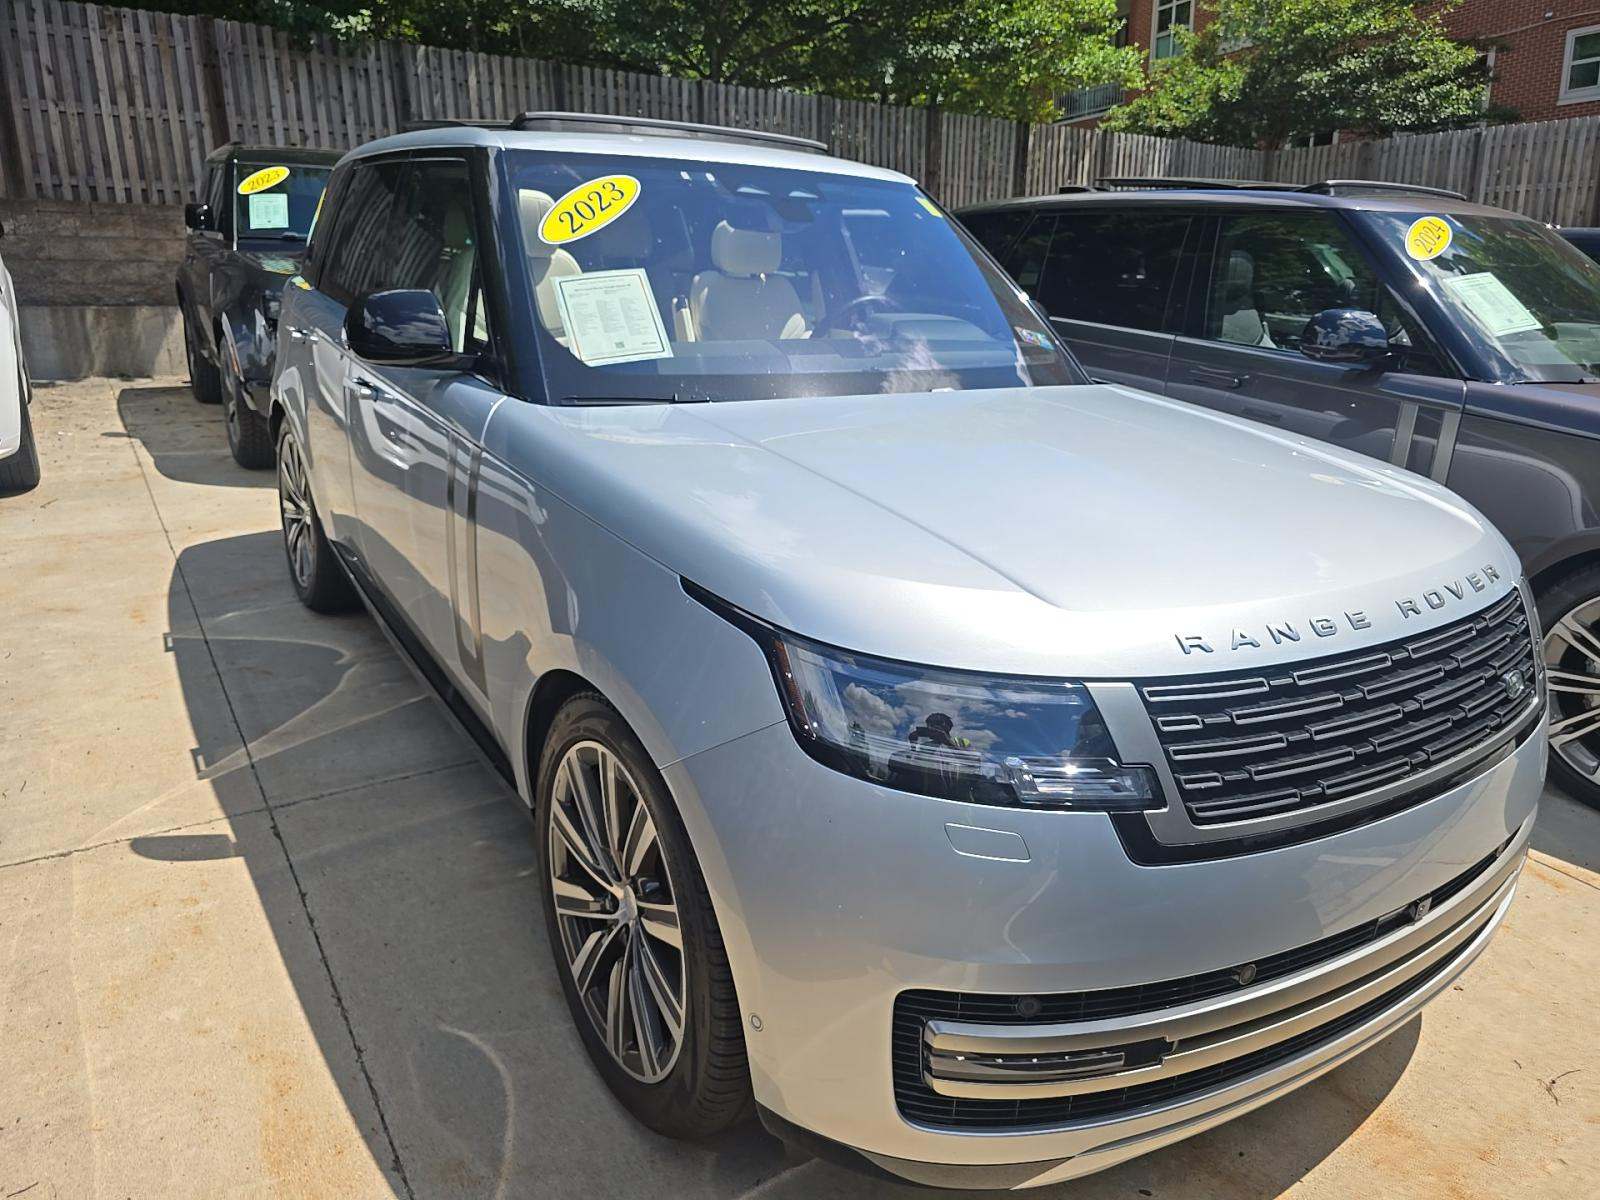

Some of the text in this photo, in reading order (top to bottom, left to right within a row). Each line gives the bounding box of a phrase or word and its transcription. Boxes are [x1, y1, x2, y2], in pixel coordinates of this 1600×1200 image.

[247, 169, 281, 190] 2023
[558, 181, 625, 234] 2023
[1413, 221, 1447, 254] 2024
[1174, 563, 1501, 655] RANGE ROVER
